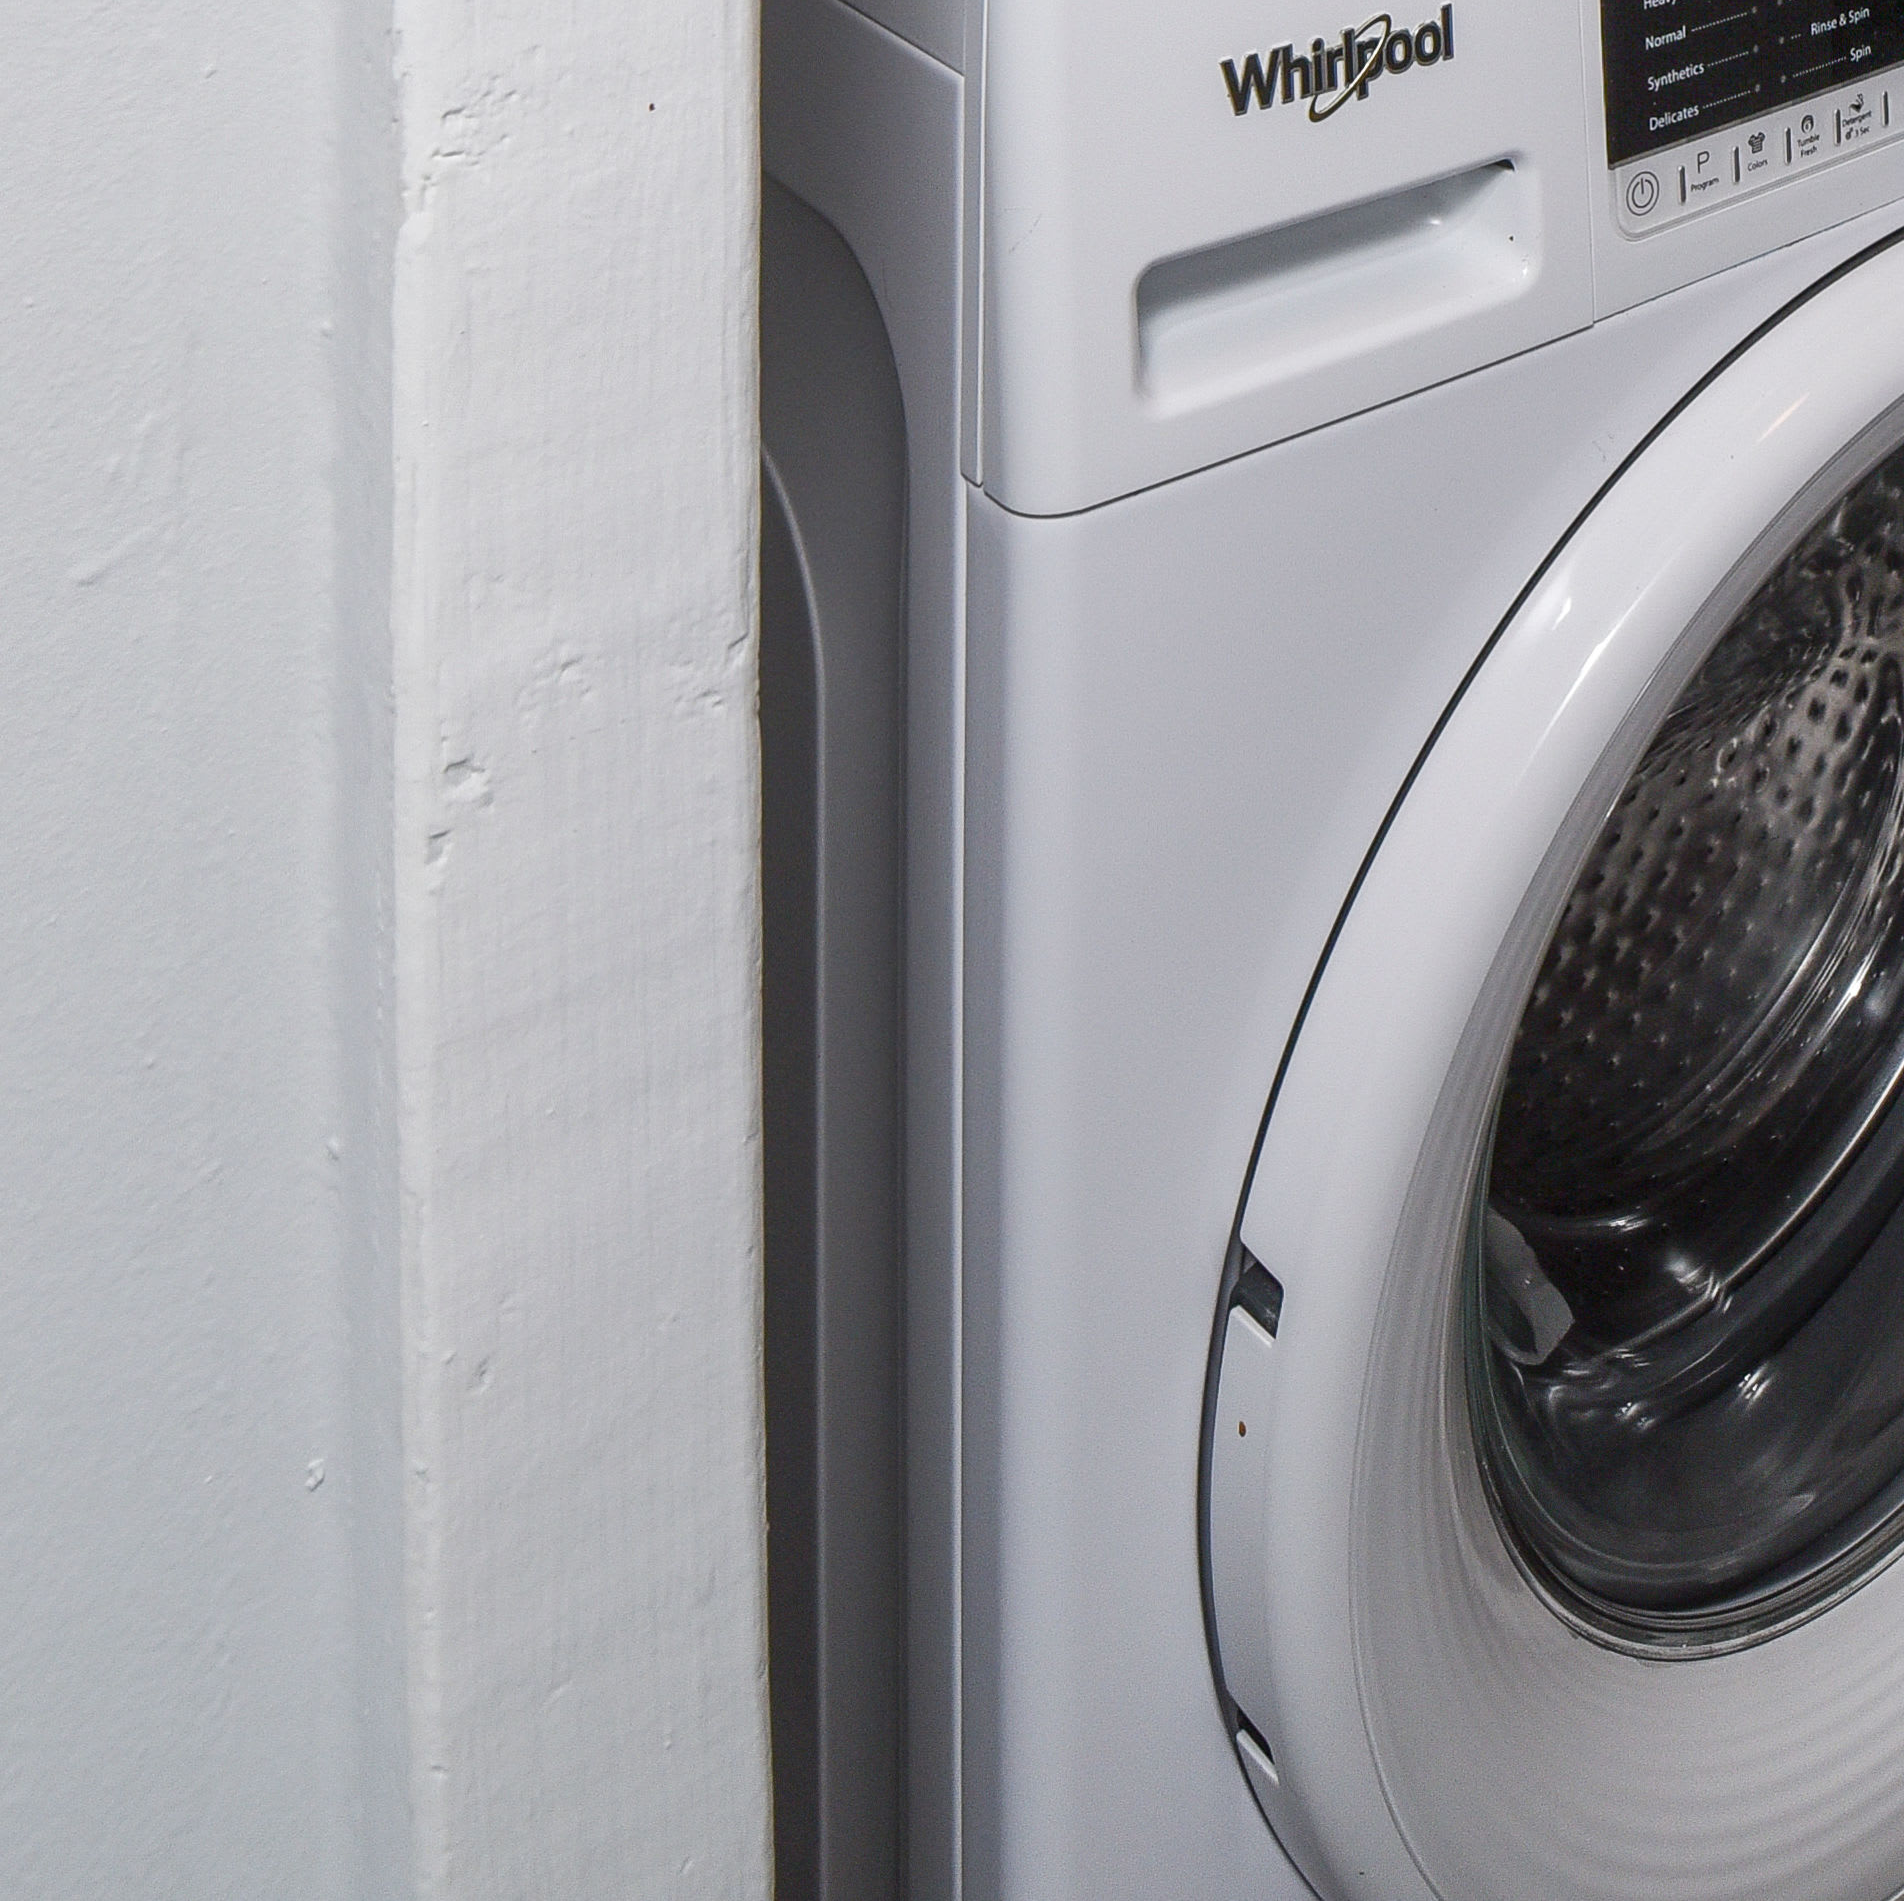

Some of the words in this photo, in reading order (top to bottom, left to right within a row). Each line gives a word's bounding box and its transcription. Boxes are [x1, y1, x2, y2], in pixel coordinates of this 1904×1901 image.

[1810, 19, 1838, 36] Rinse
[1839, 13, 1846, 26] &
[1848, 7, 1870, 25] Spin
[1645, 25, 1686, 50] Normal
[1219, 2, 1455, 122] Whirlpool
[1850, 45, 1872, 63] Spin
[1648, 62, 1705, 91] Synthetics
[1649, 105, 1699, 131] Delicates
[1842, 110, 1872, 128] Detergent
[1797, 132, 1820, 147] Tumble
[1860, 125, 1870, 136] Sec
[1800, 146, 1817, 158] Fresh
[1747, 158, 1768, 172] Colors
[1690, 176, 1719, 192] Program
